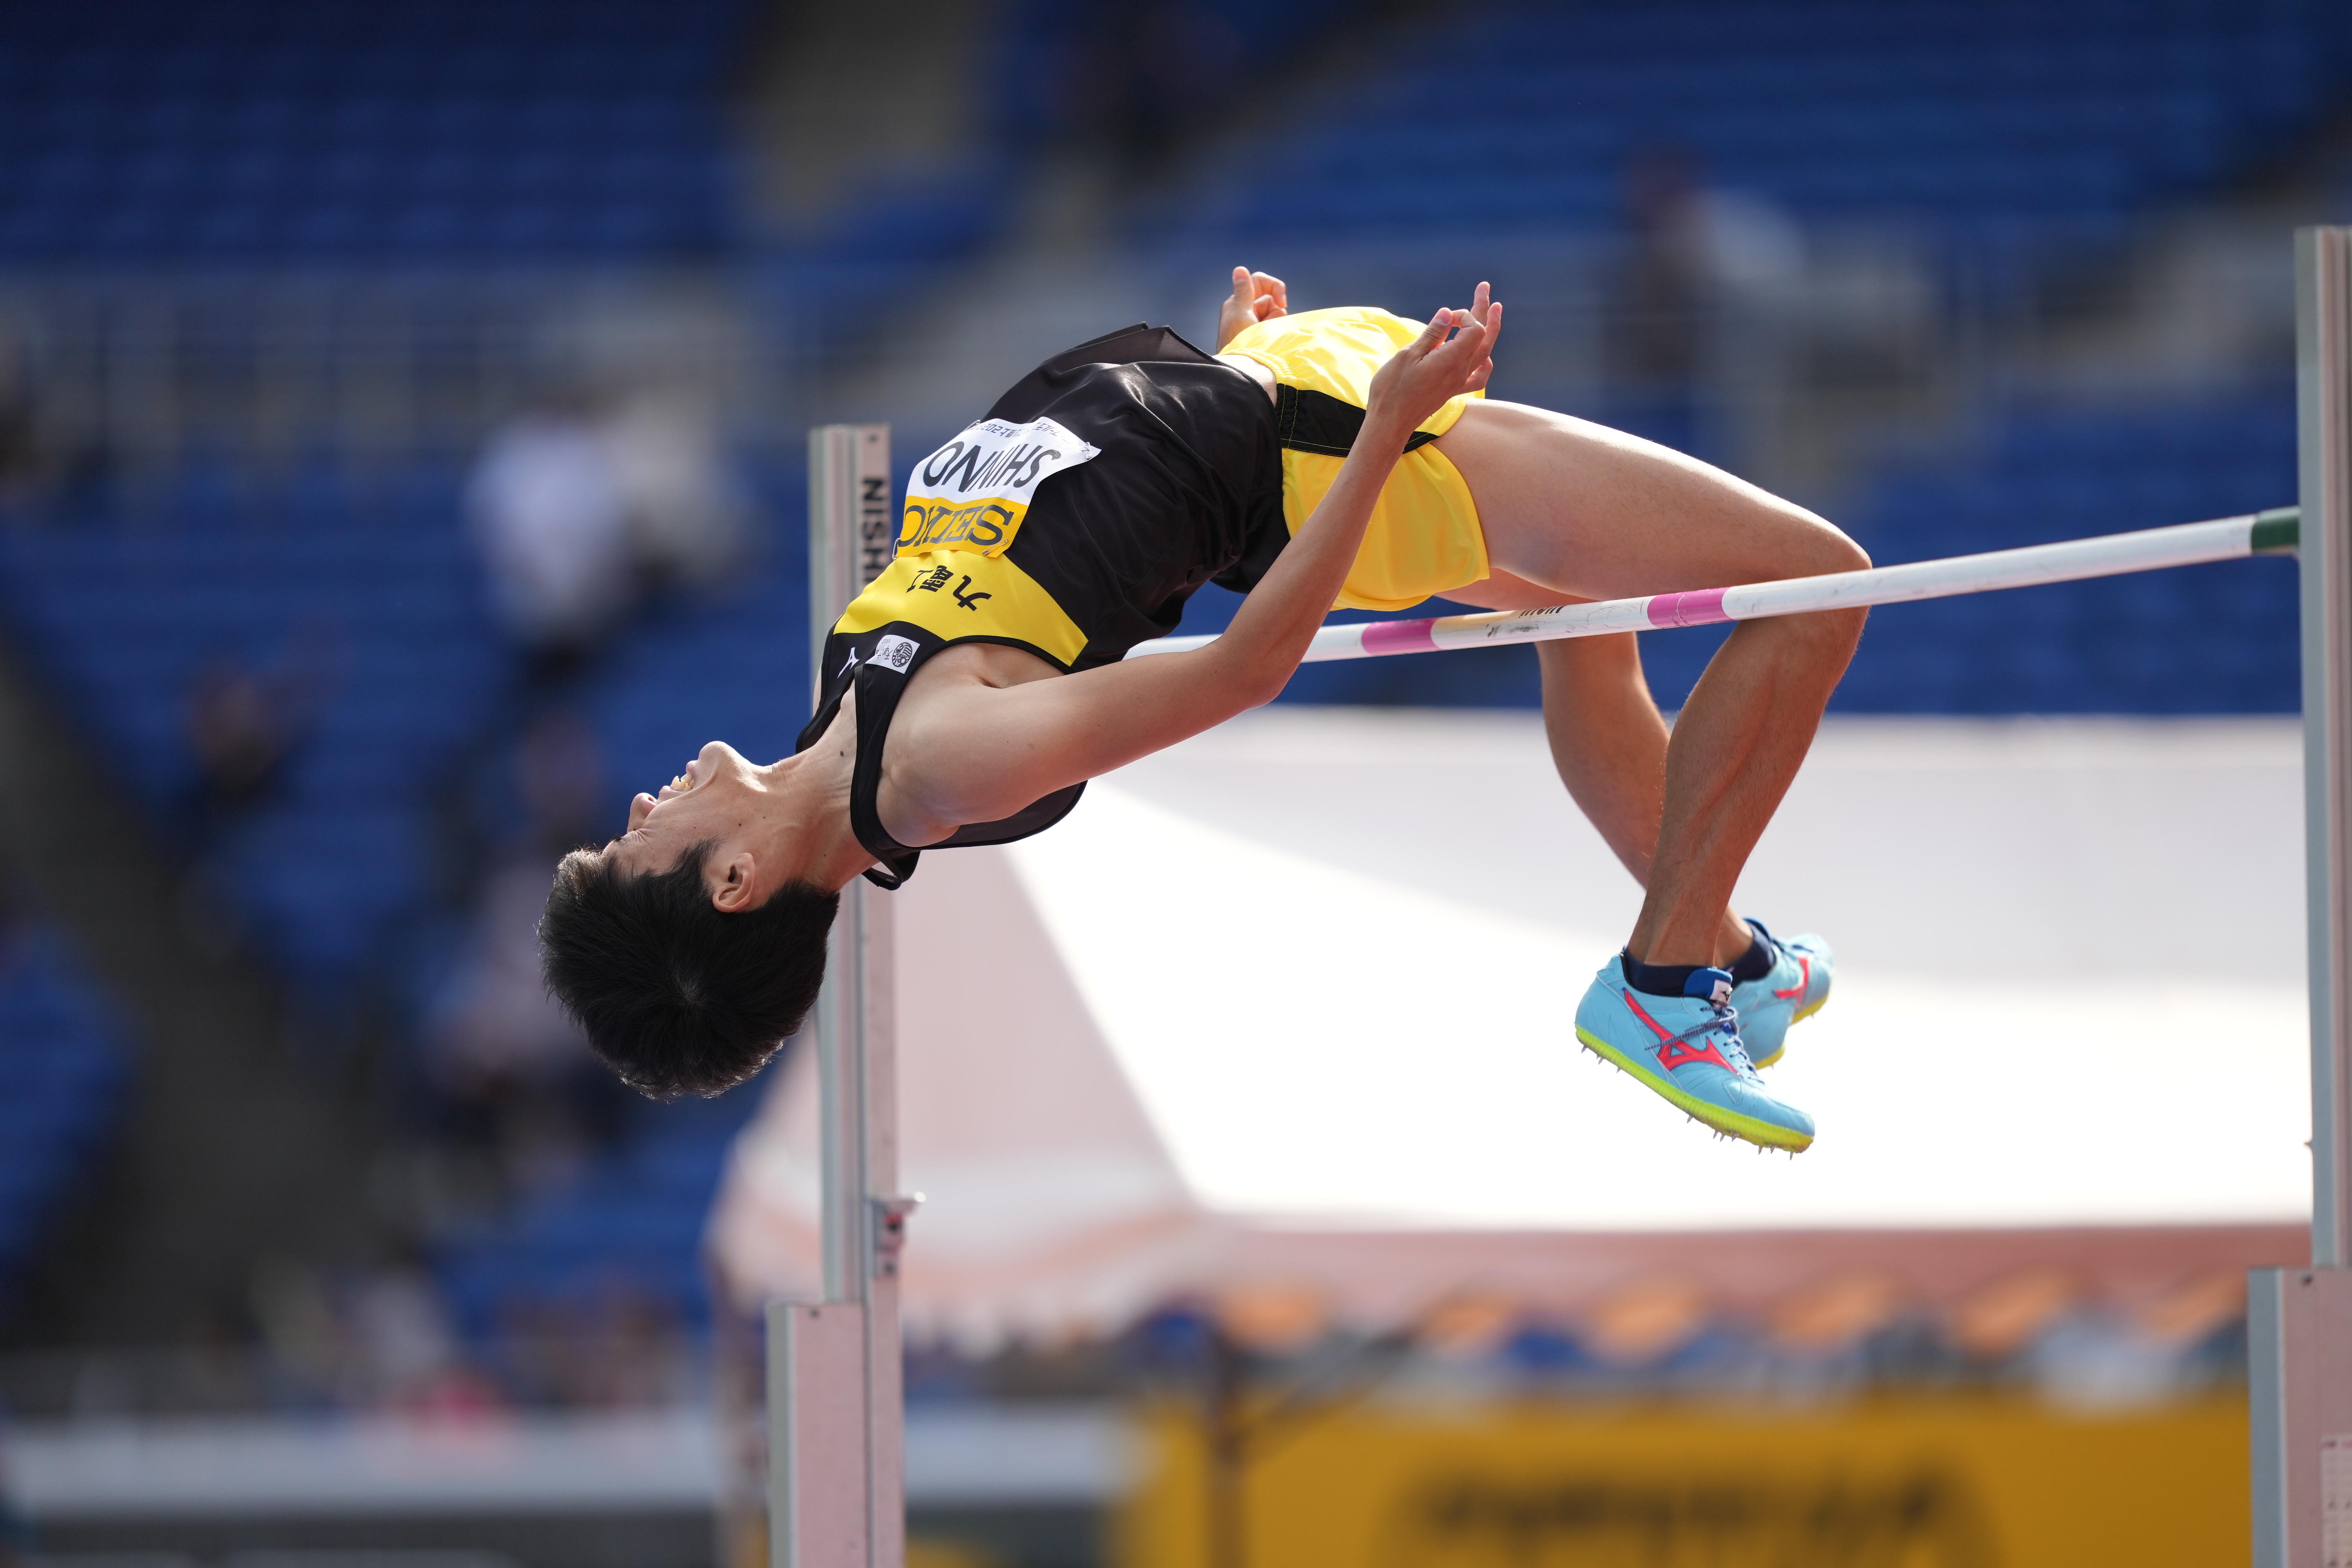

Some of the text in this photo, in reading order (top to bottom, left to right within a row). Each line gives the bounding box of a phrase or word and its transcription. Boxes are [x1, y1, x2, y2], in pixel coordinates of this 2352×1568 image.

[923, 441, 1061, 493] SHINNO
[897, 505, 1015, 548] SEIKO
[906, 565, 992, 611] 九電工
